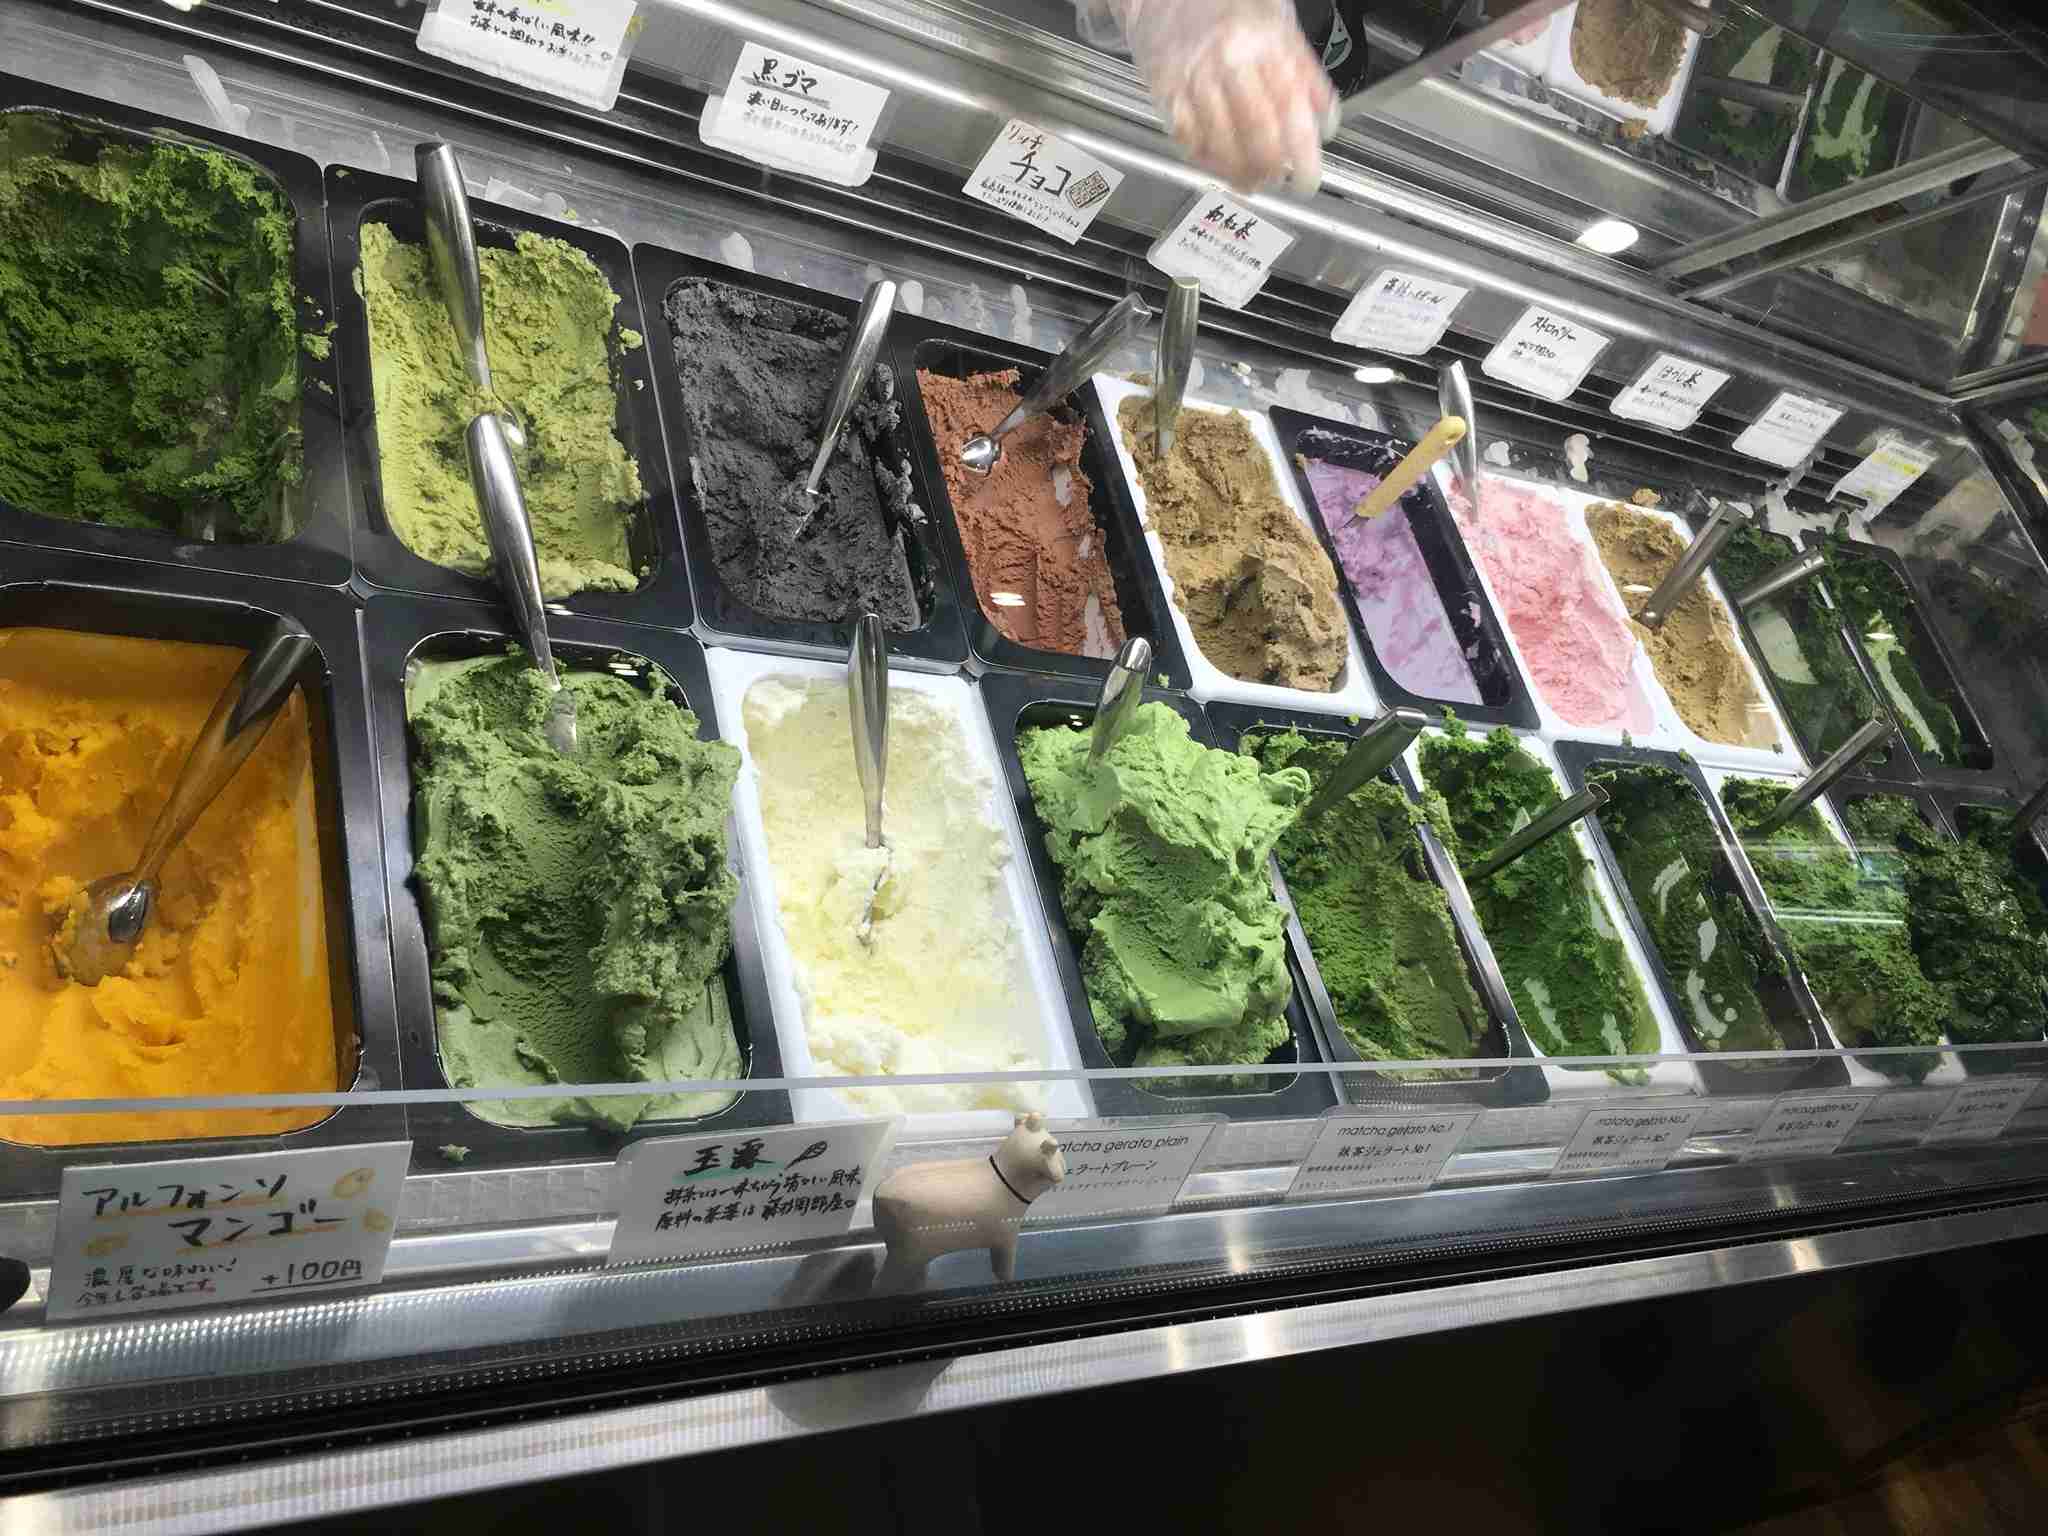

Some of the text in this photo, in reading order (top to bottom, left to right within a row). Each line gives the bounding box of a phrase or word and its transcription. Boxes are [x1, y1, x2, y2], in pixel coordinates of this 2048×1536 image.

[753, 57, 818, 94] 黒ゴマ
[1010, 151, 1072, 197] チョコ
[1056, 1139, 1101, 1153] atcha
[1155, 1135, 1189, 1151] plain
[1337, 1124, 1386, 1137] matcha
[684, 1137, 773, 1177] 玉露
[82, 1174, 288, 1217] アルフォンソ
[167, 1199, 347, 1246] マンゴー
[261, 1259, 362, 1286] +100円
